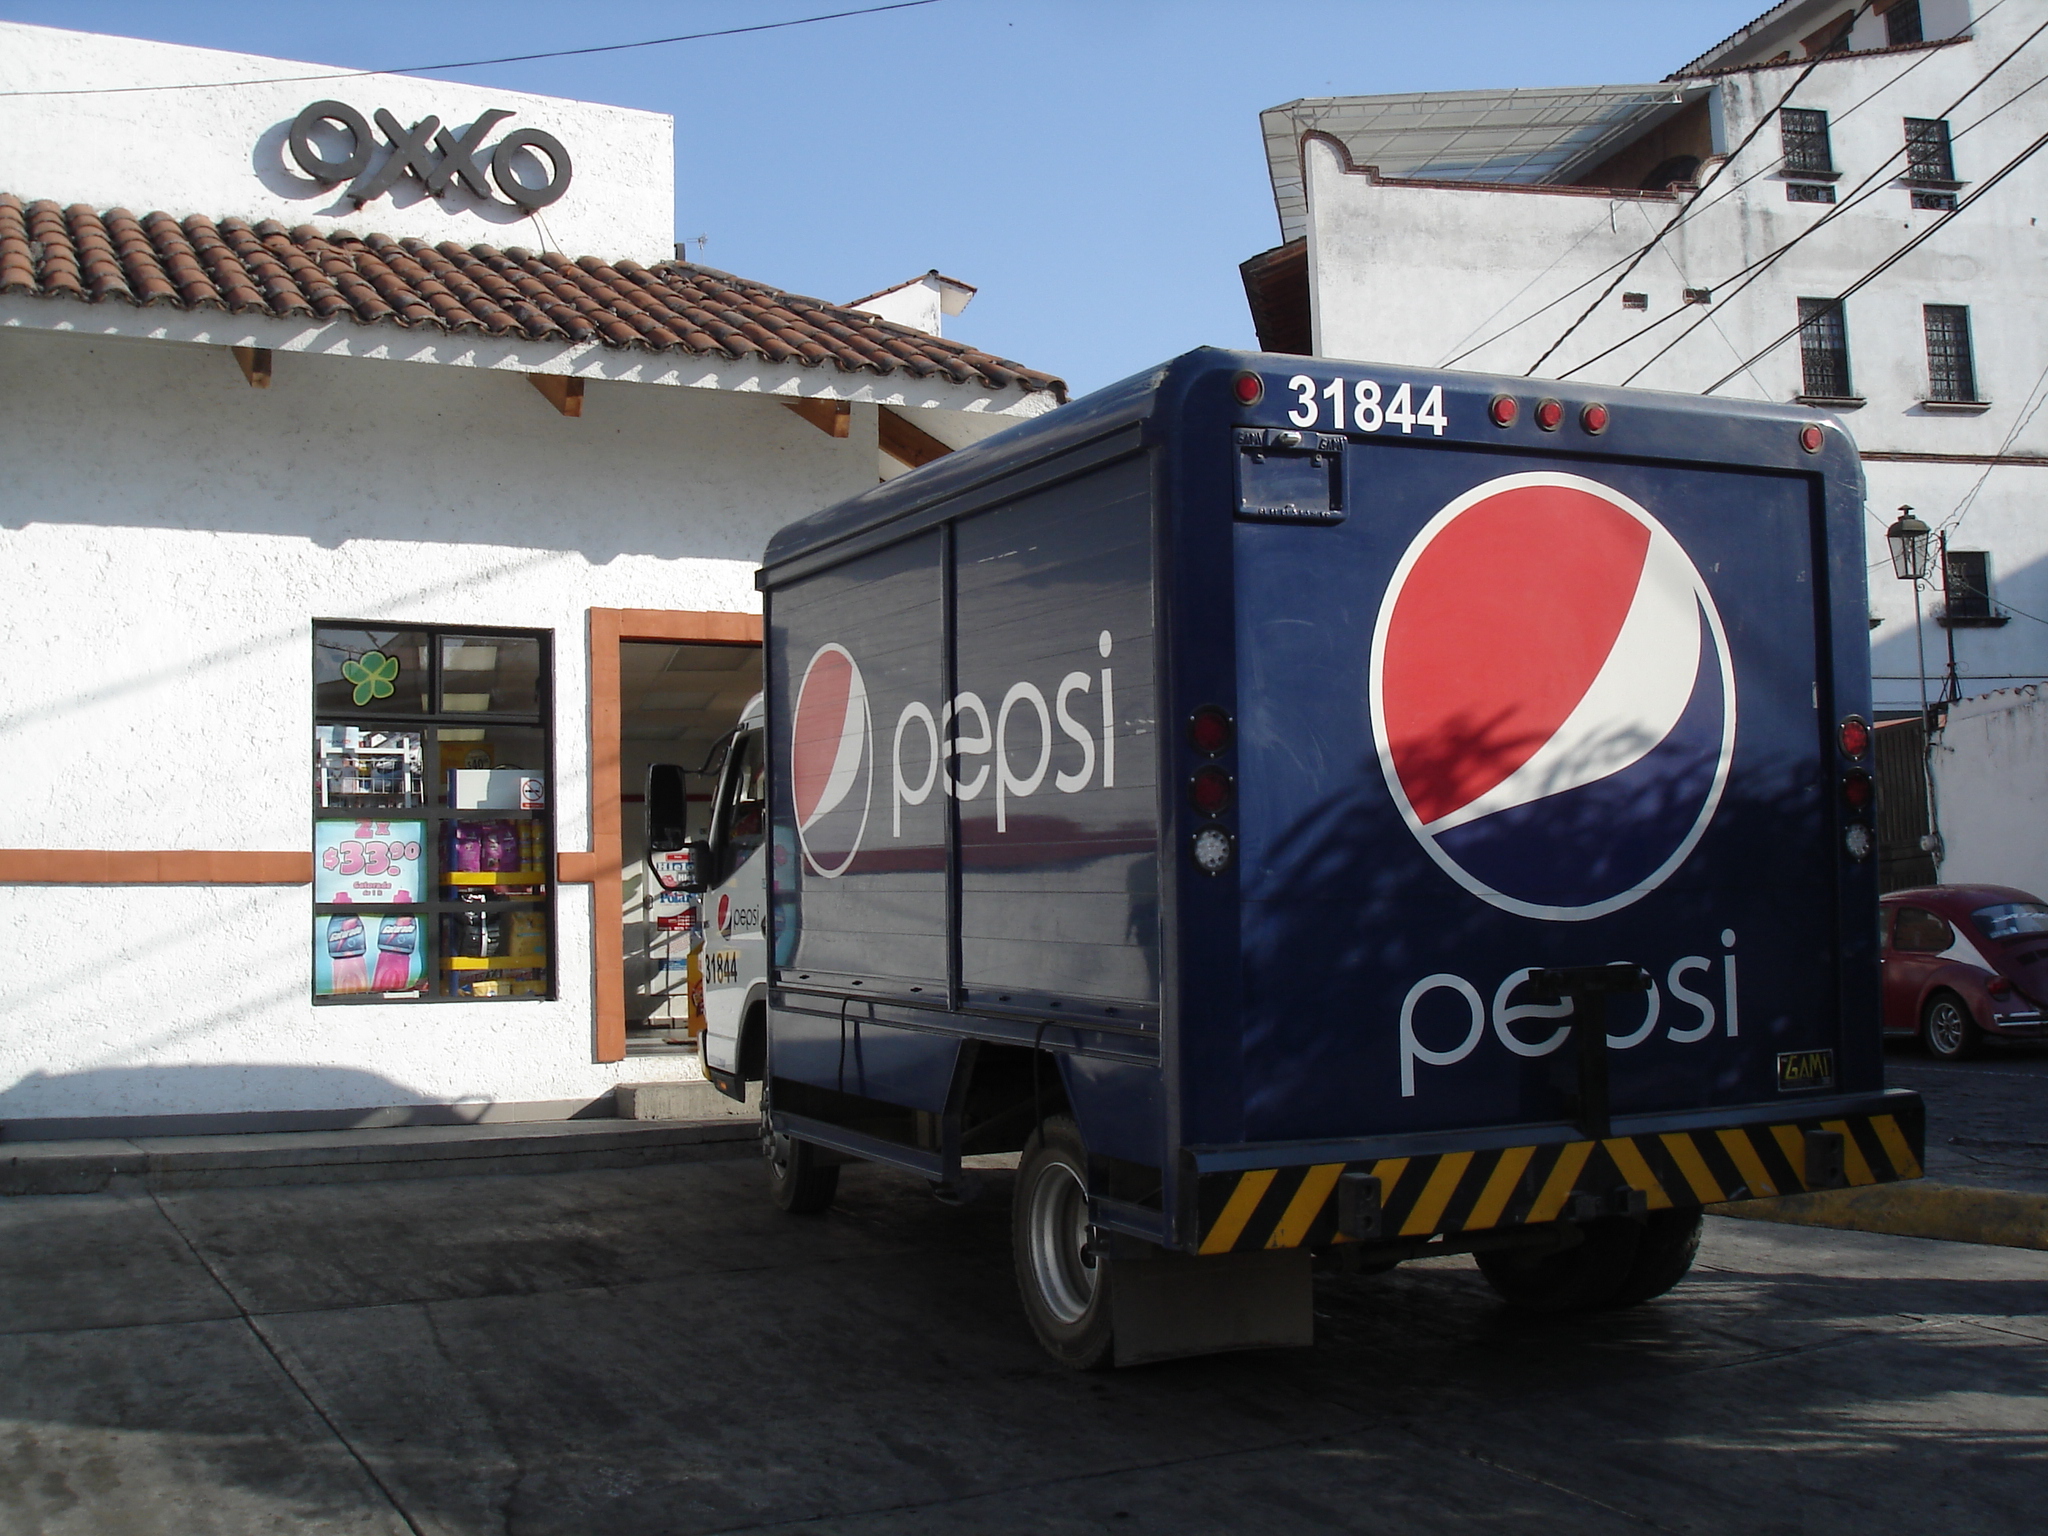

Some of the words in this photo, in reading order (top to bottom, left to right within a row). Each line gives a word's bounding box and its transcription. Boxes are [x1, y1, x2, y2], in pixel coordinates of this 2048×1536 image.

[289, 100, 571, 209] OXXO
[1288, 375, 1448, 436] 31844
[893, 630, 1114, 838] pepsi
[355, 818, 373, 839] 2
[733, 904, 760, 930] pepsi
[705, 951, 738, 984] 31844
